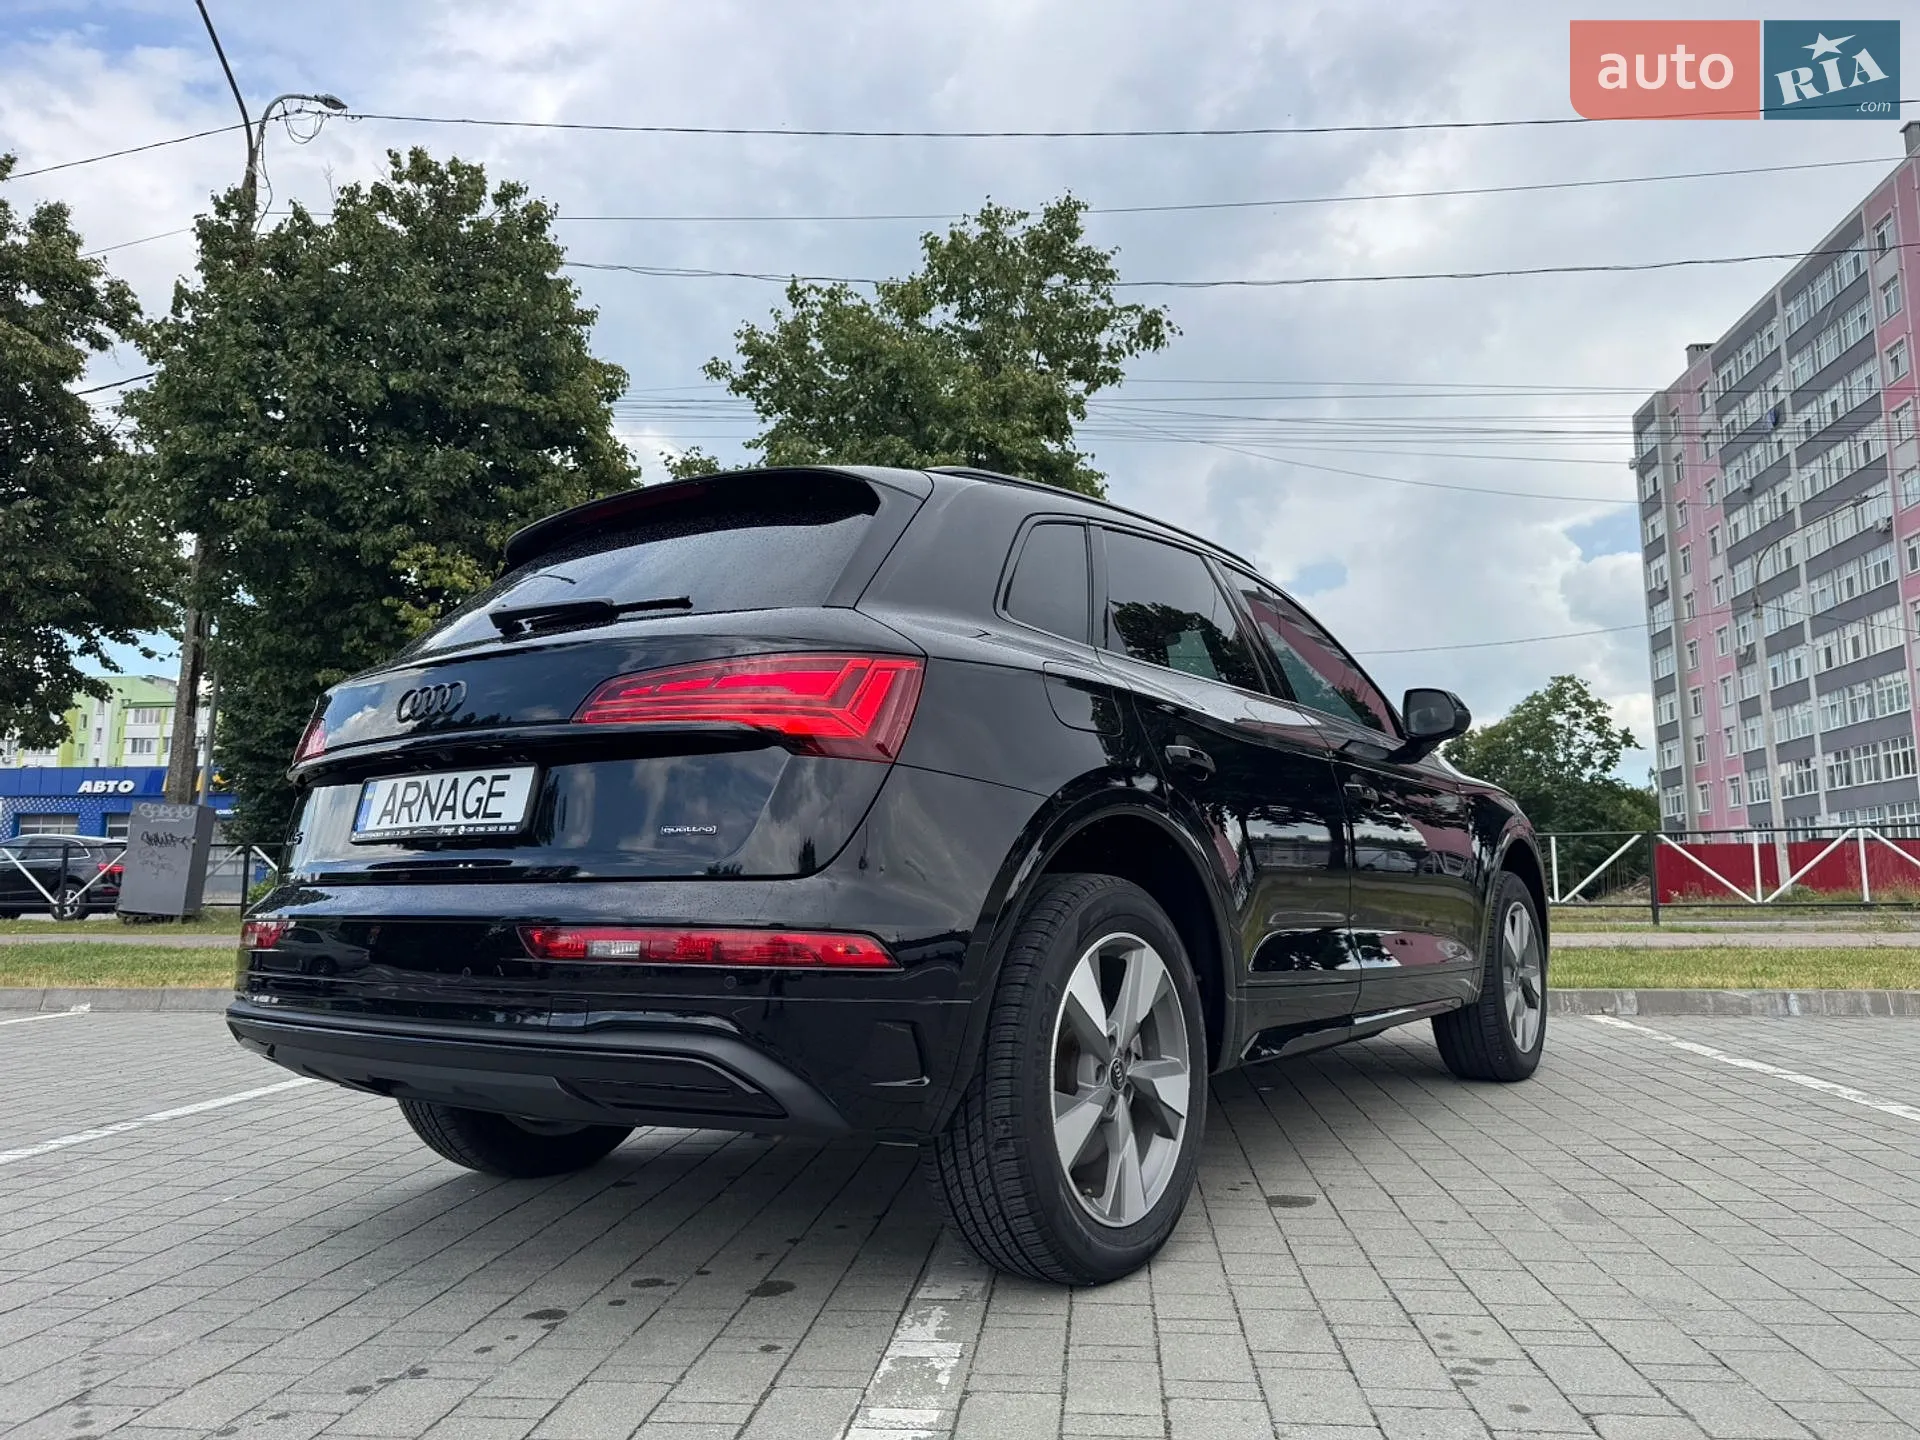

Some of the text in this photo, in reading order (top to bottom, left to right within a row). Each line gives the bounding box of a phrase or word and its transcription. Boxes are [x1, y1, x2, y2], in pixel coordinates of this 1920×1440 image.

[77, 779, 135, 793] АВТО
[376, 774, 511, 826] ARNAGE
[662, 825, 716, 835] quattro
